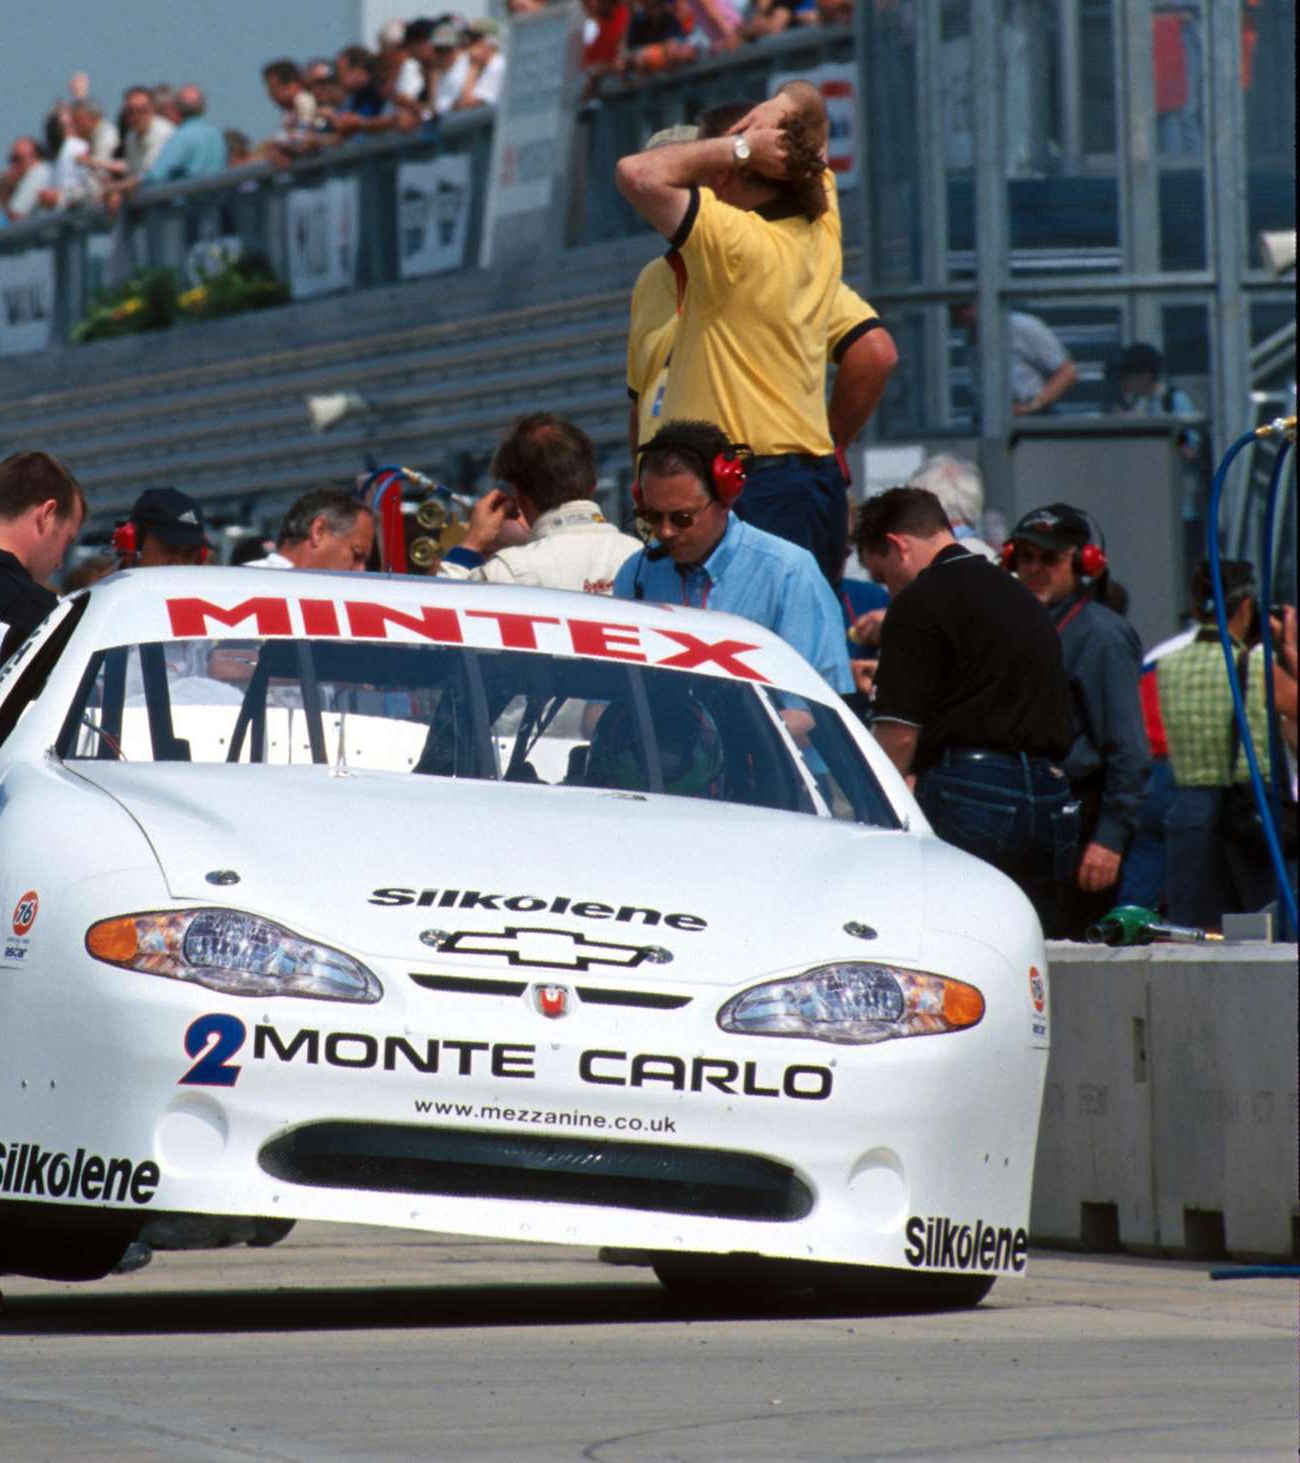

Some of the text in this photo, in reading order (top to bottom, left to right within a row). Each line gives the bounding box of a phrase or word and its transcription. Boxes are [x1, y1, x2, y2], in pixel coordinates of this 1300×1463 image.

[166, 598, 773, 684] MINTEX
[14, 900, 37, 926] 76
[367, 887, 708, 932] Silkolene
[177, 1012, 247, 1088] 2
[253, 1024, 834, 1101] MONTE CARLO
[414, 1100, 677, 1134] www.mezzanine.co.uk
[904, 1216, 1028, 1272] Silkolene
